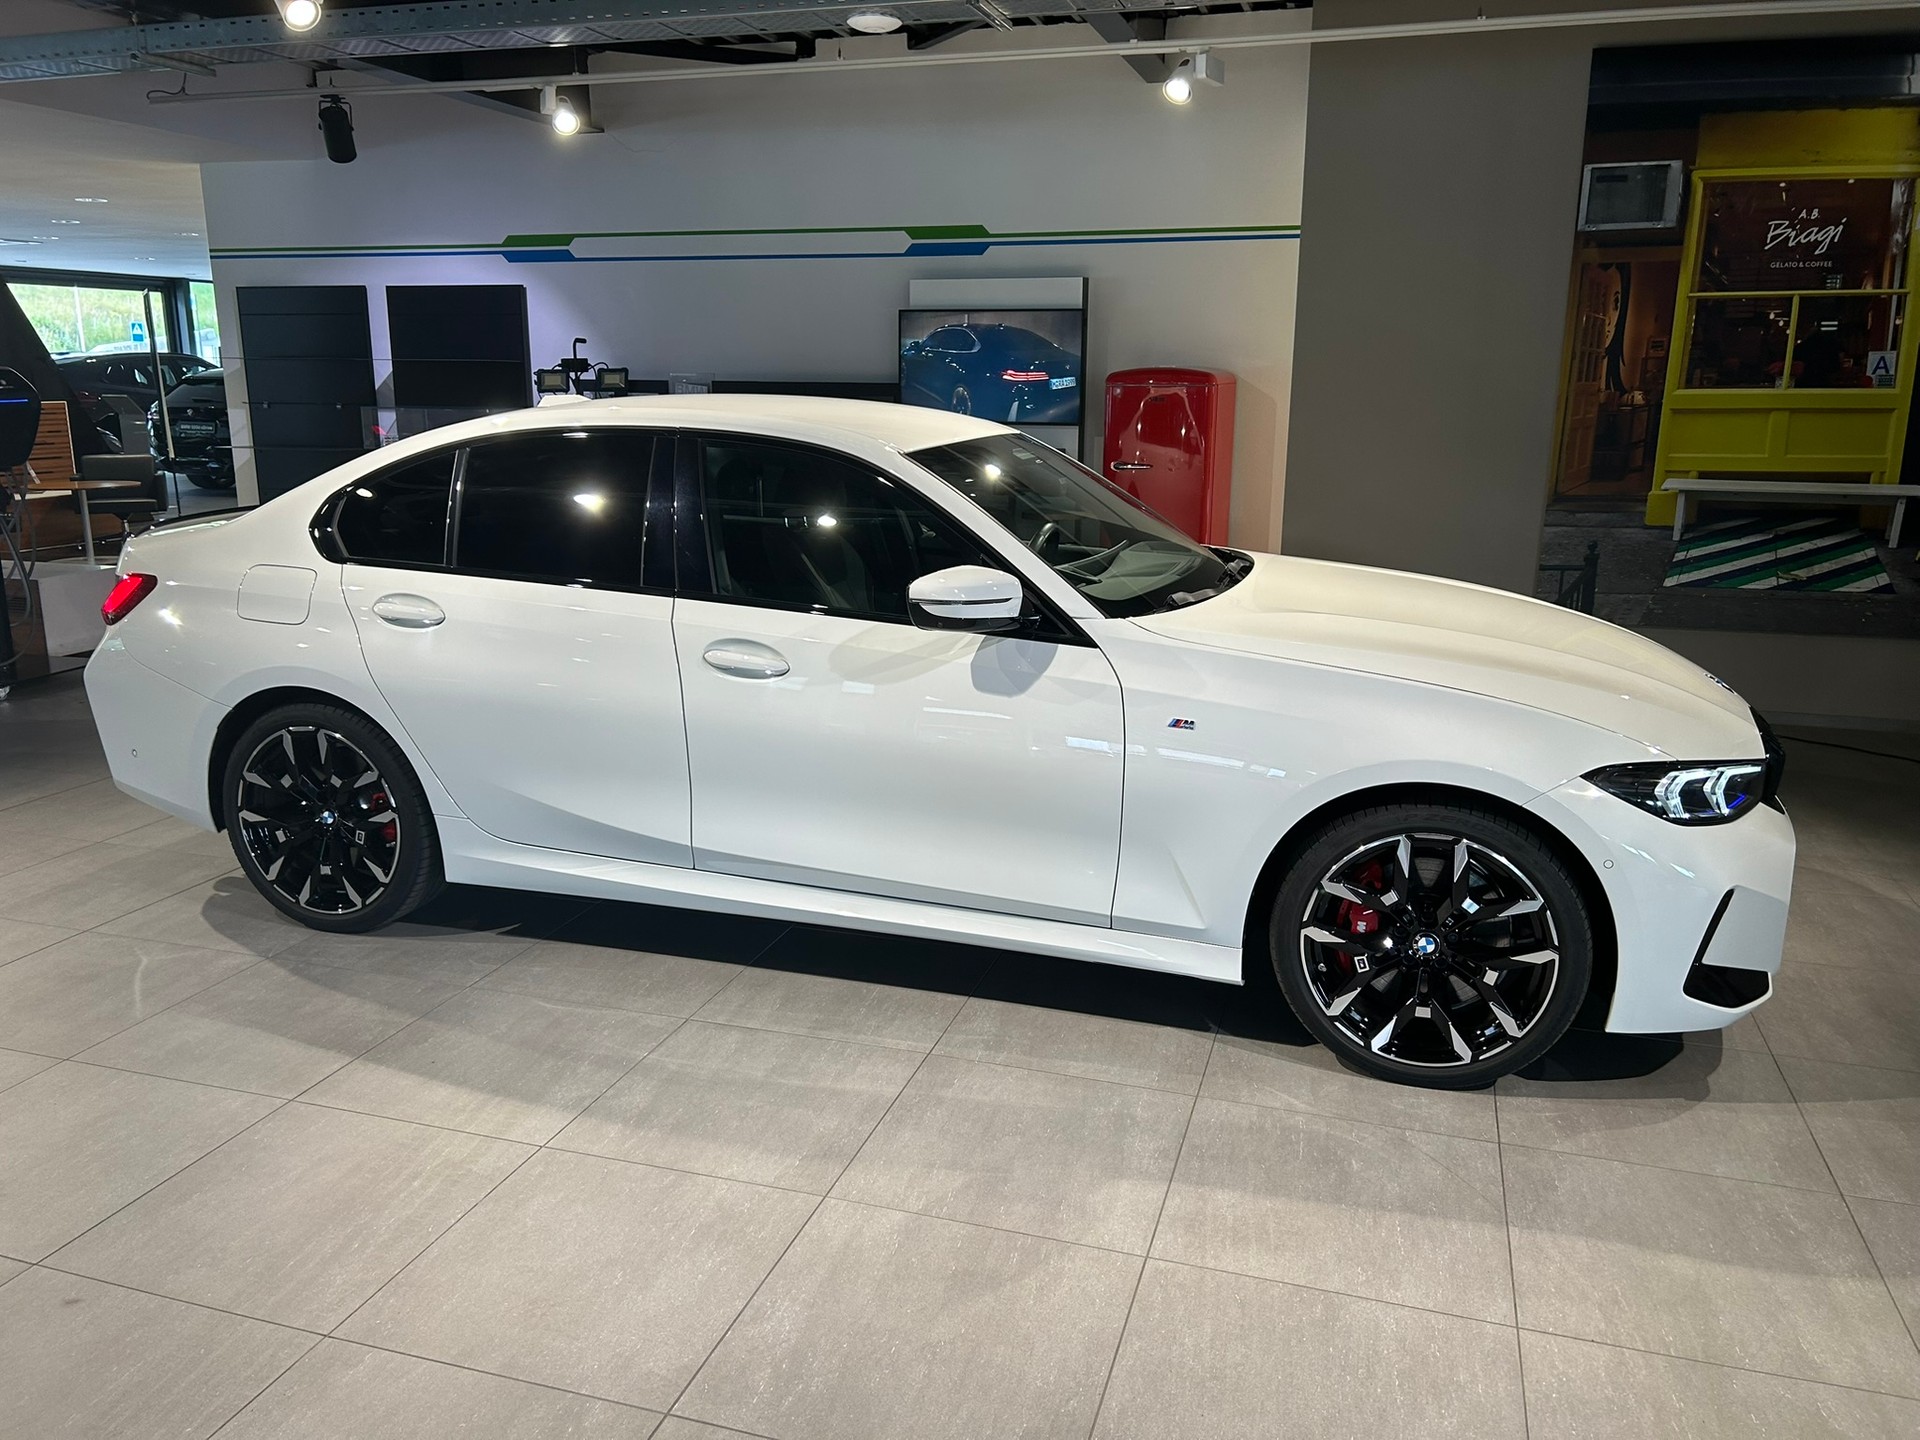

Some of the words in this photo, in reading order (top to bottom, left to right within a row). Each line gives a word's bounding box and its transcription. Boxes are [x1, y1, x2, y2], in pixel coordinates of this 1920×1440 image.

[1798, 208, 1821, 220] A.B.
[1764, 217, 1847, 255] Biagi
[1770, 261, 1798, 269] GELATO
[1805, 260, 1833, 268] COFFEE
[1871, 355, 1890, 375] A
